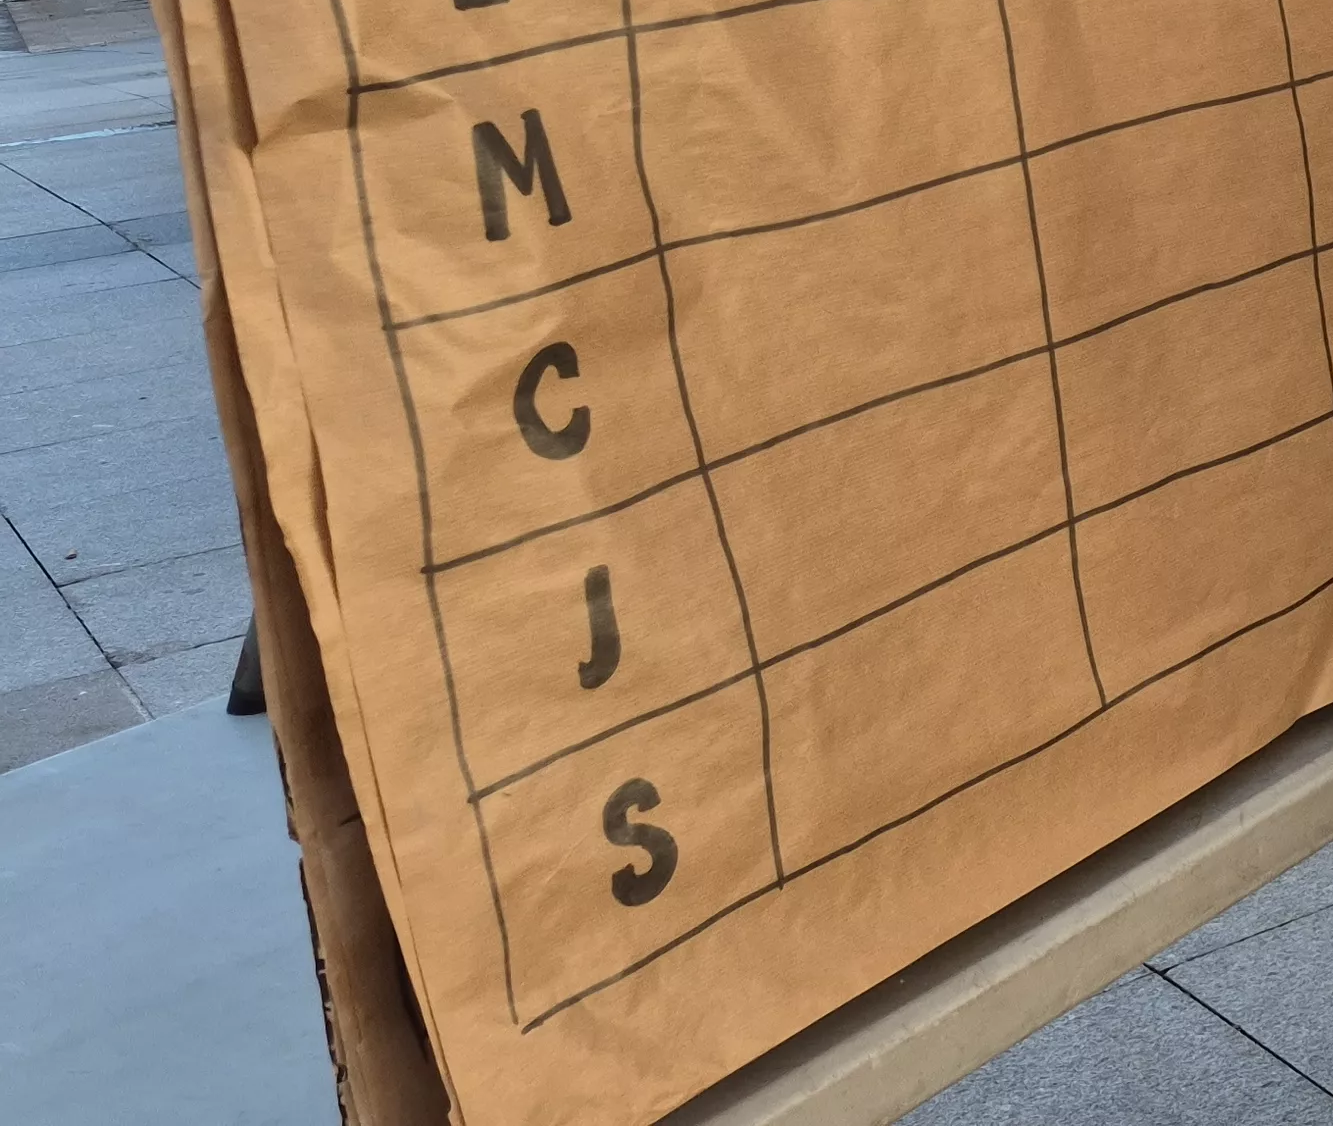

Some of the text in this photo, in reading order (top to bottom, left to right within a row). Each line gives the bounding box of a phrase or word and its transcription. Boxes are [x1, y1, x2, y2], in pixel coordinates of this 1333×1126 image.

[472, 108, 573, 241] M
[513, 340, 592, 460] C
[578, 564, 621, 689] J
[602, 777, 679, 907] S
